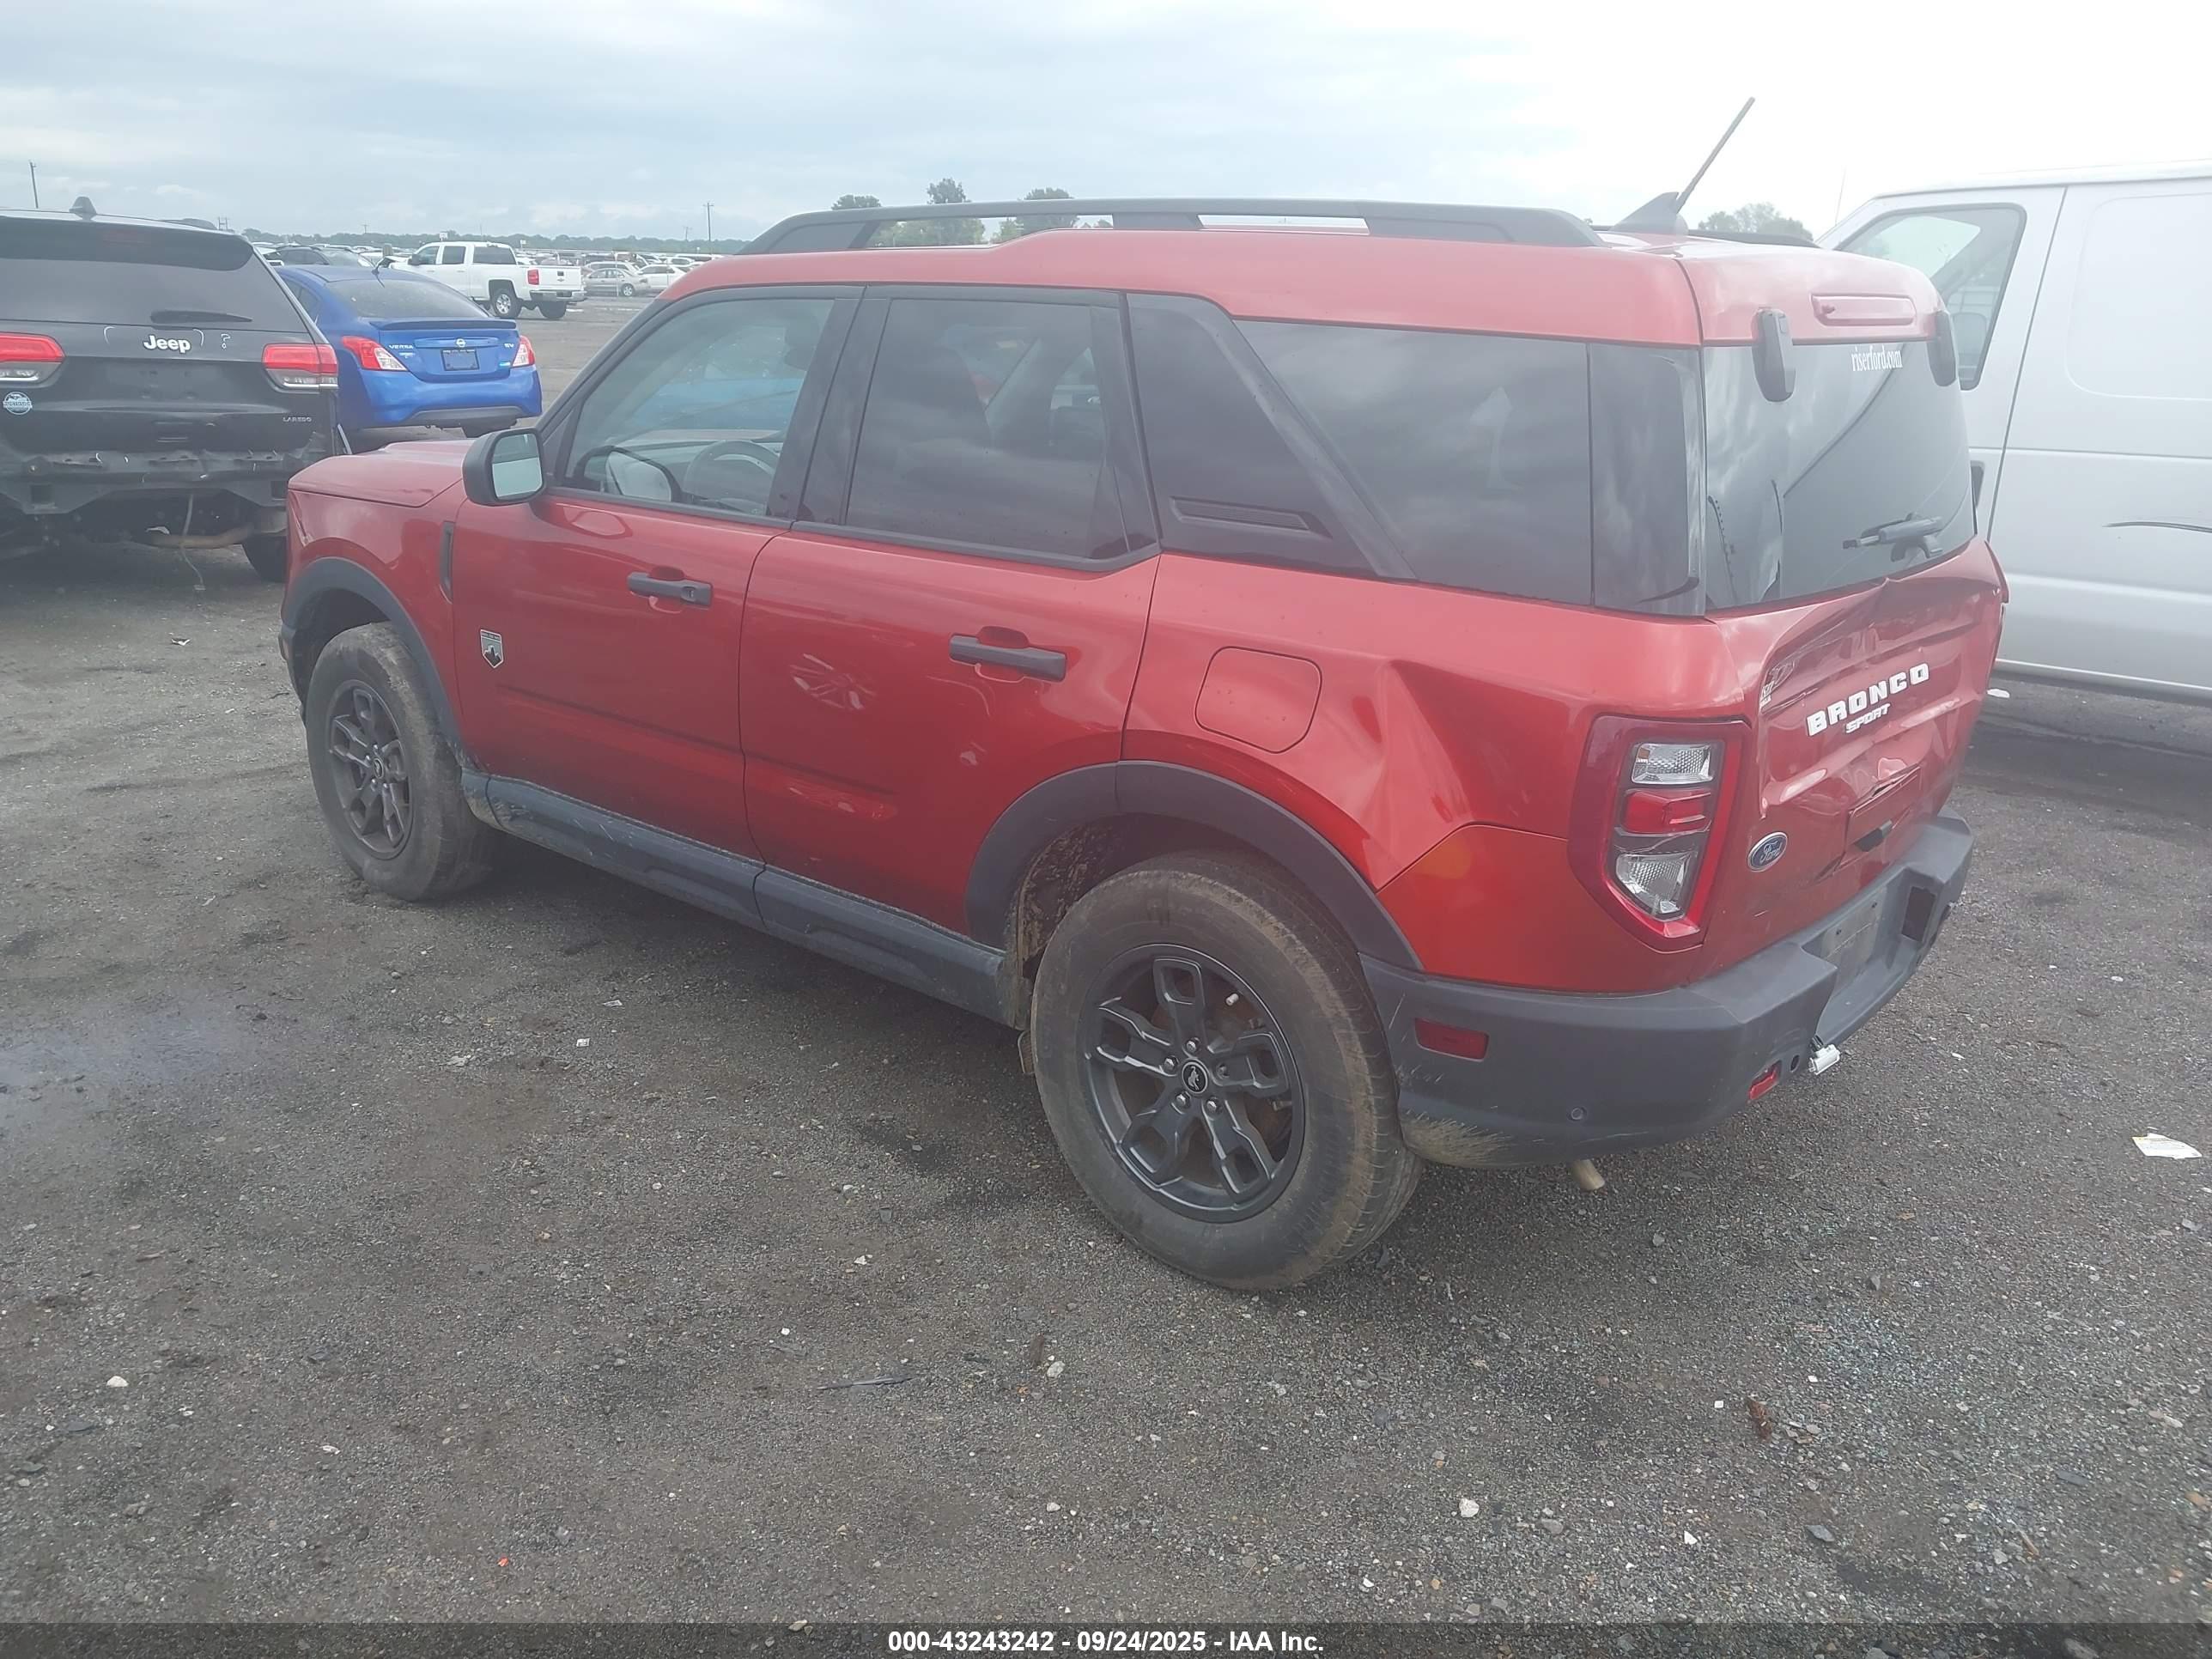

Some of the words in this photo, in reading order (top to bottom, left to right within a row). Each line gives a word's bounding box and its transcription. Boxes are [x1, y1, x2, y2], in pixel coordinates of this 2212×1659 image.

[143, 335, 191, 353] Jeep
[1851, 345, 1903, 371] riserford.com
[1807, 663, 1929, 737] BRONCO
[1845, 702, 1891, 733] SPORT
